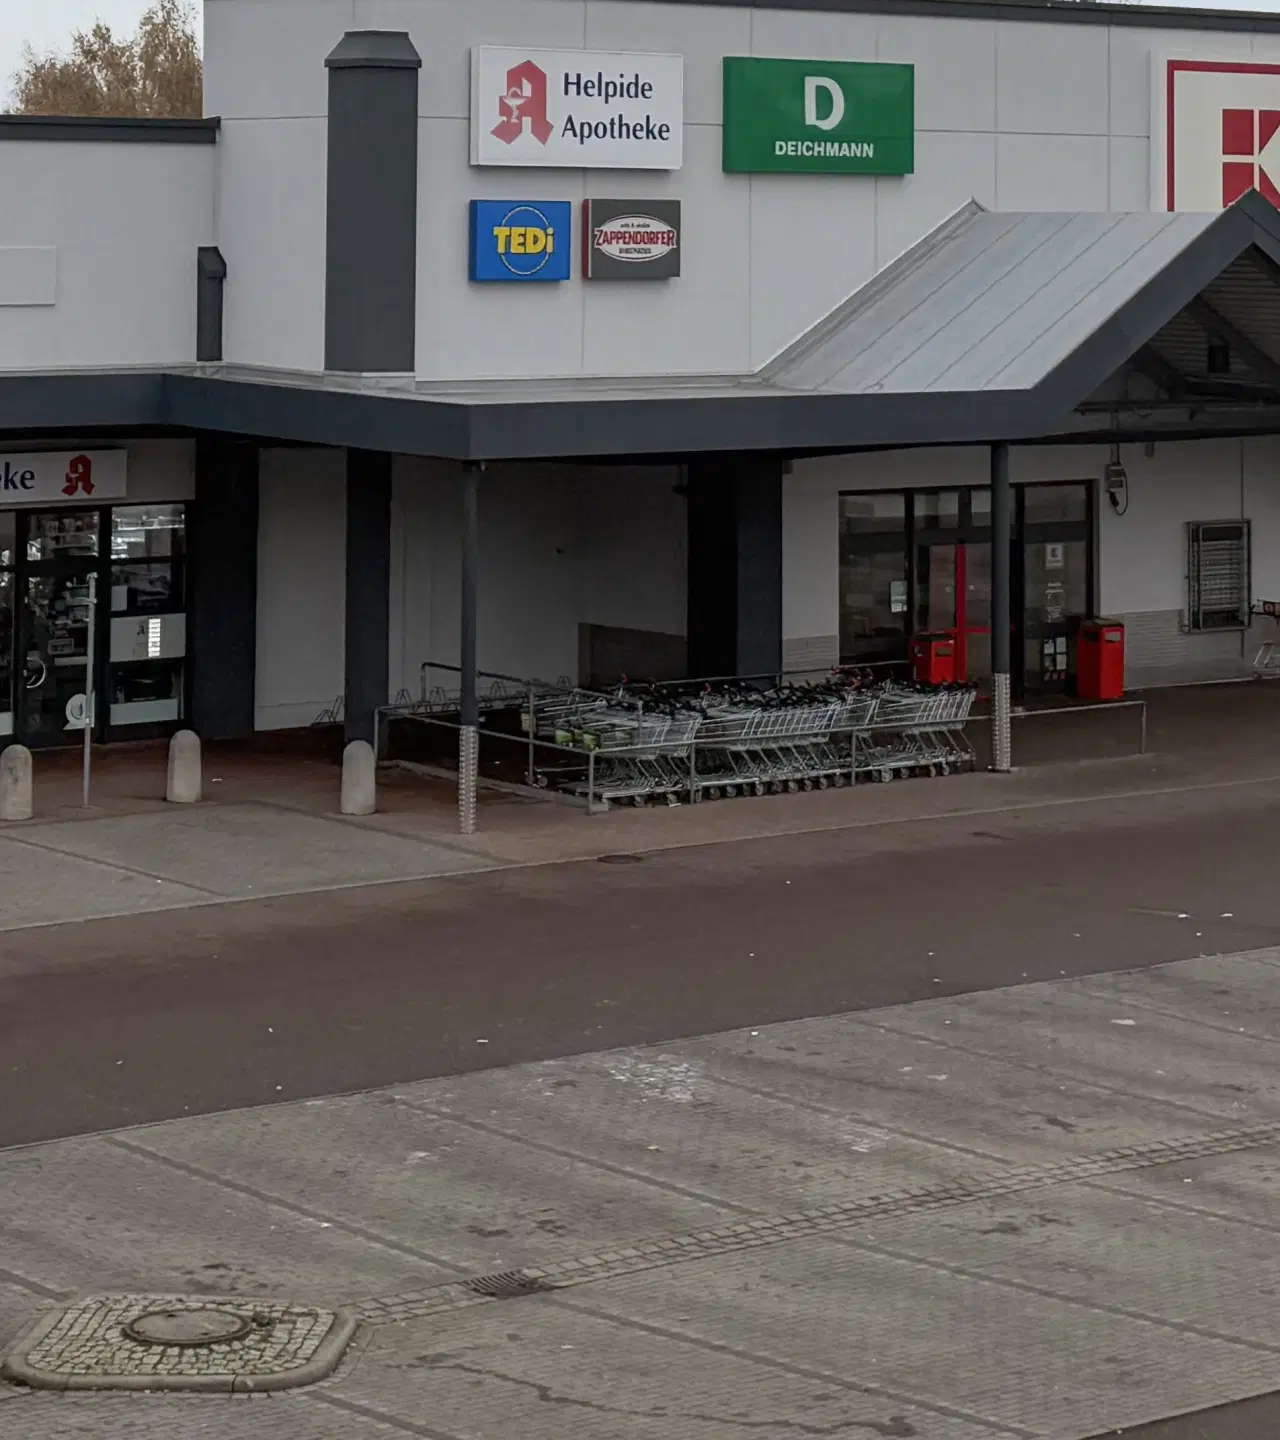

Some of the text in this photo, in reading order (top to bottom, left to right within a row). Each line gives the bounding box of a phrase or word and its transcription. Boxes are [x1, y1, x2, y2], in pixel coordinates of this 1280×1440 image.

[563, 71, 653, 104] Helpide
[804, 76, 845, 130] D
[561, 113, 670, 145] Apotheke
[775, 141, 875, 158] DEICHMANN
[493, 226, 554, 254] TEDi
[594, 228, 677, 247] ZAPPENDORFER
